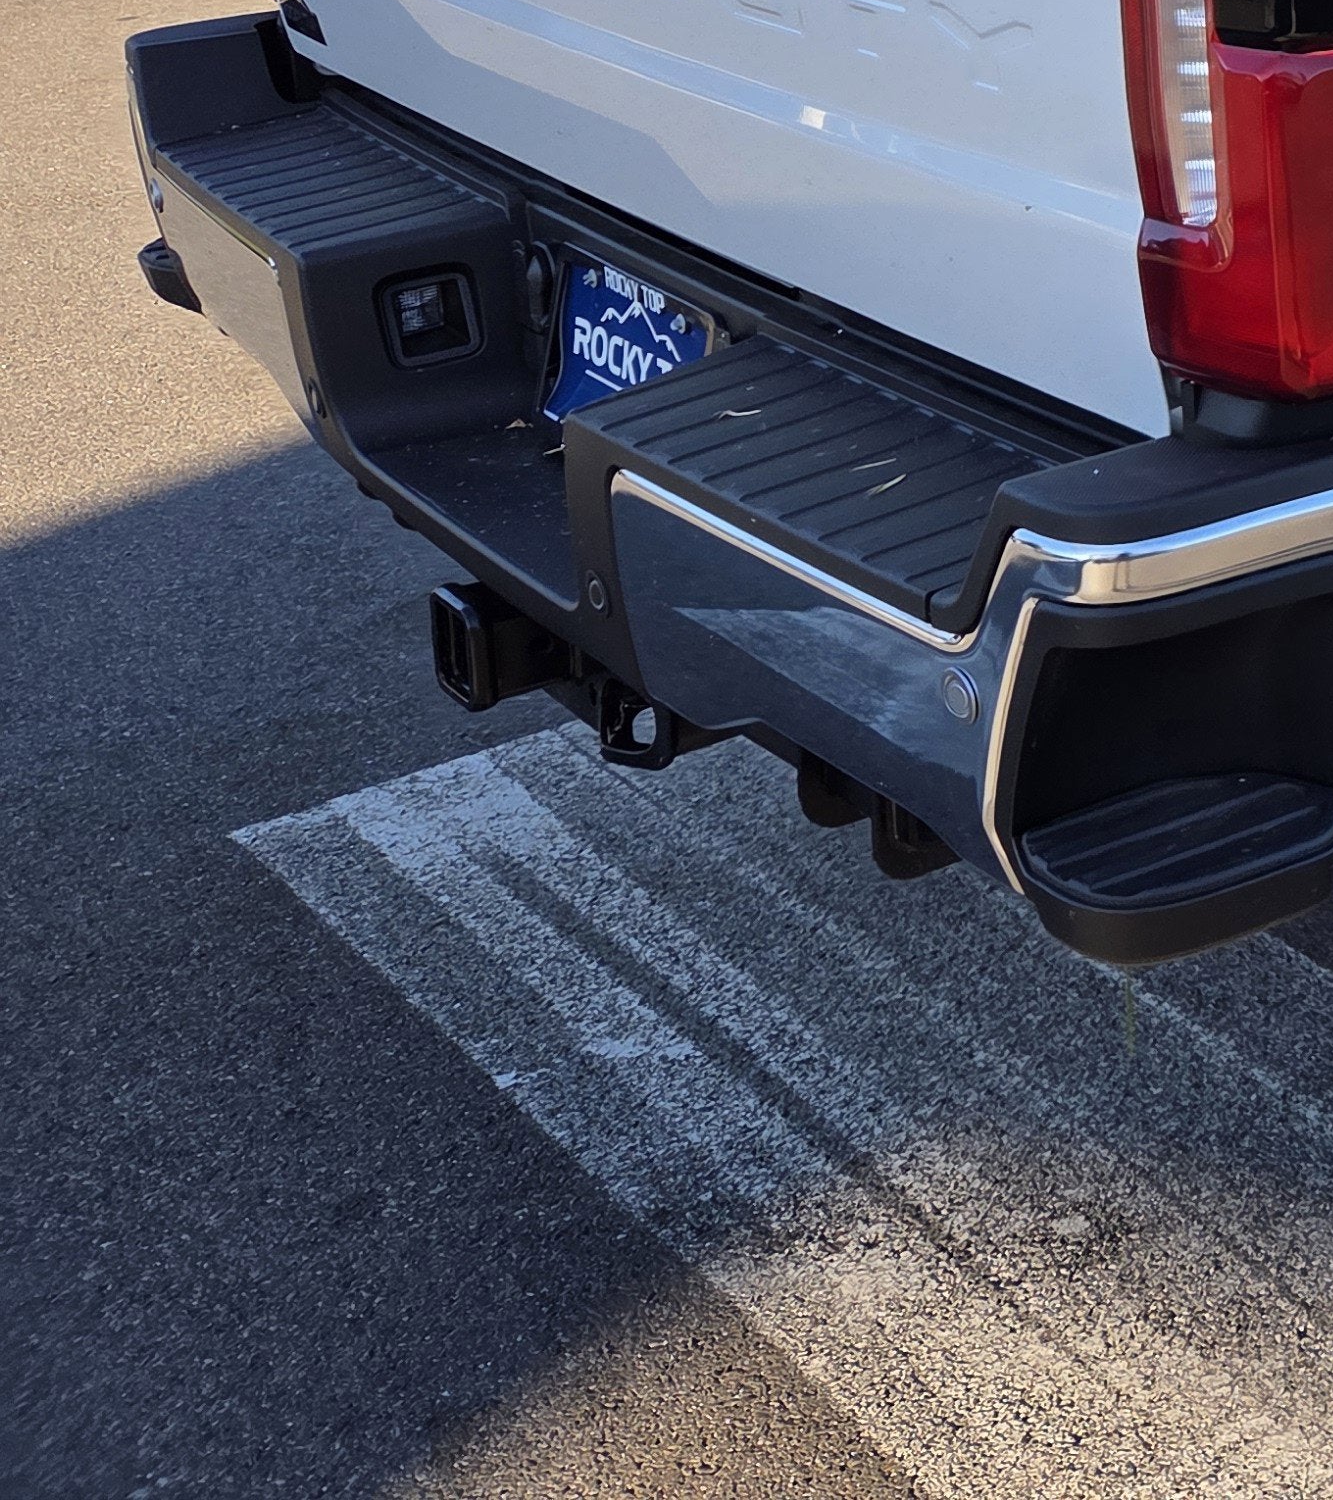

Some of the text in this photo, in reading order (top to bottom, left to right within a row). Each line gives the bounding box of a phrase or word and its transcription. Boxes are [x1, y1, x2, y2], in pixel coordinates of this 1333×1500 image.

[603, 266, 665, 315] ROCKY TOP
[573, 316, 654, 386] ROCKY
